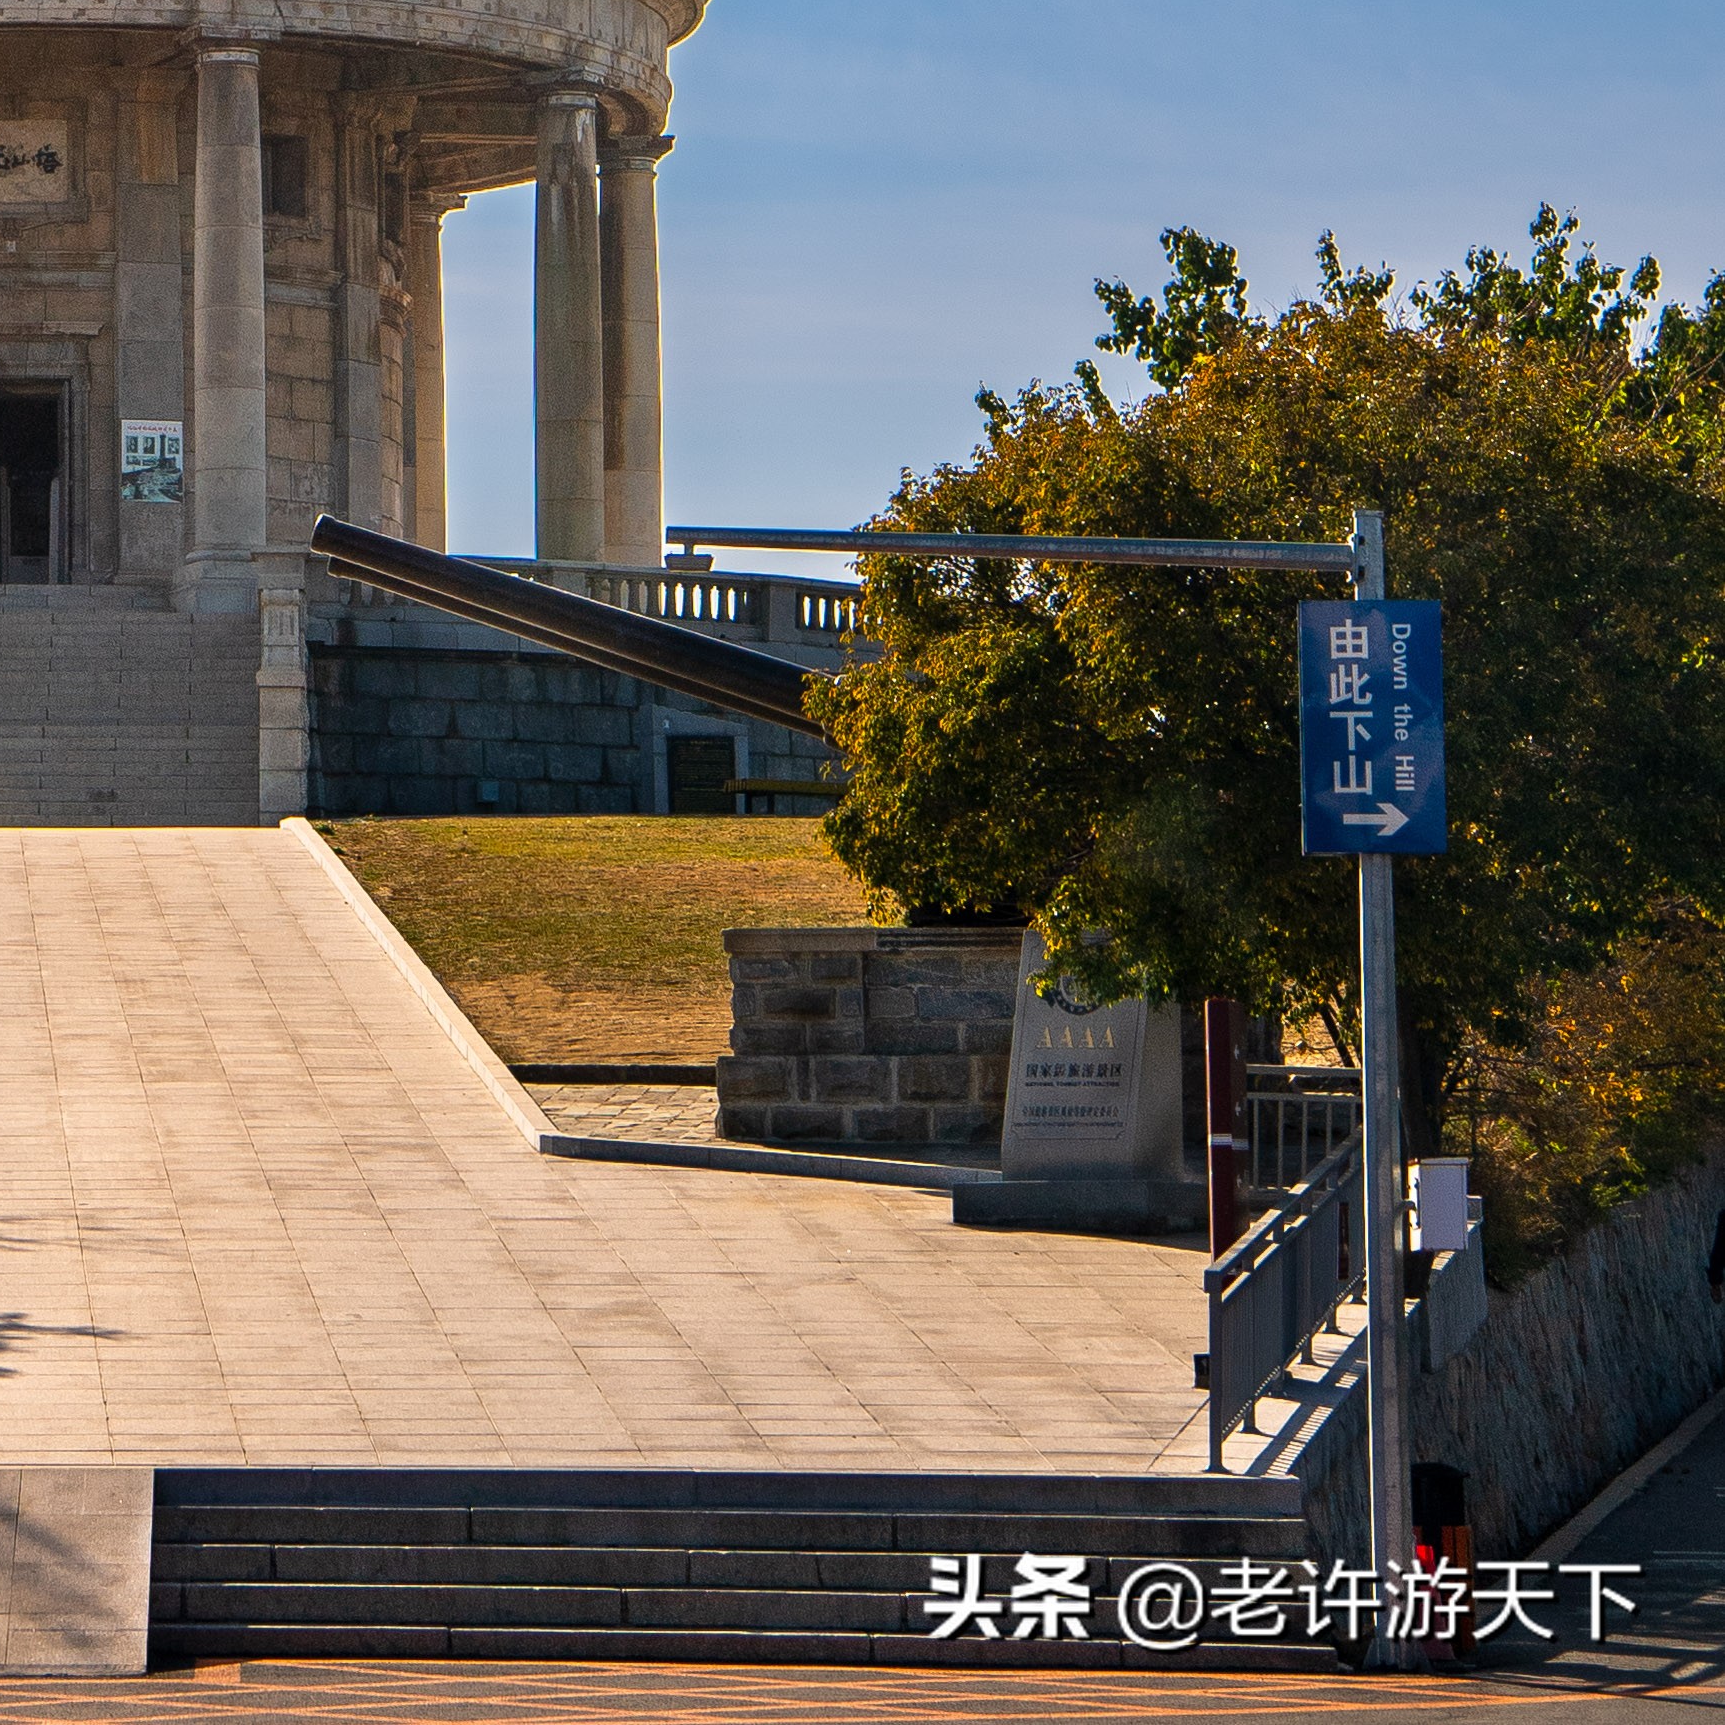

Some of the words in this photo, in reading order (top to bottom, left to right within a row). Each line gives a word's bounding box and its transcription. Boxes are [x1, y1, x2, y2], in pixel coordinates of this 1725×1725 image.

[1391, 623, 1412, 690] Down
[1329, 618, 1373, 795] 由此下山
[1394, 703, 1413, 741] the
[1395, 755, 1415, 791] Hill
[1036, 1025, 1115, 1048] AAAA
